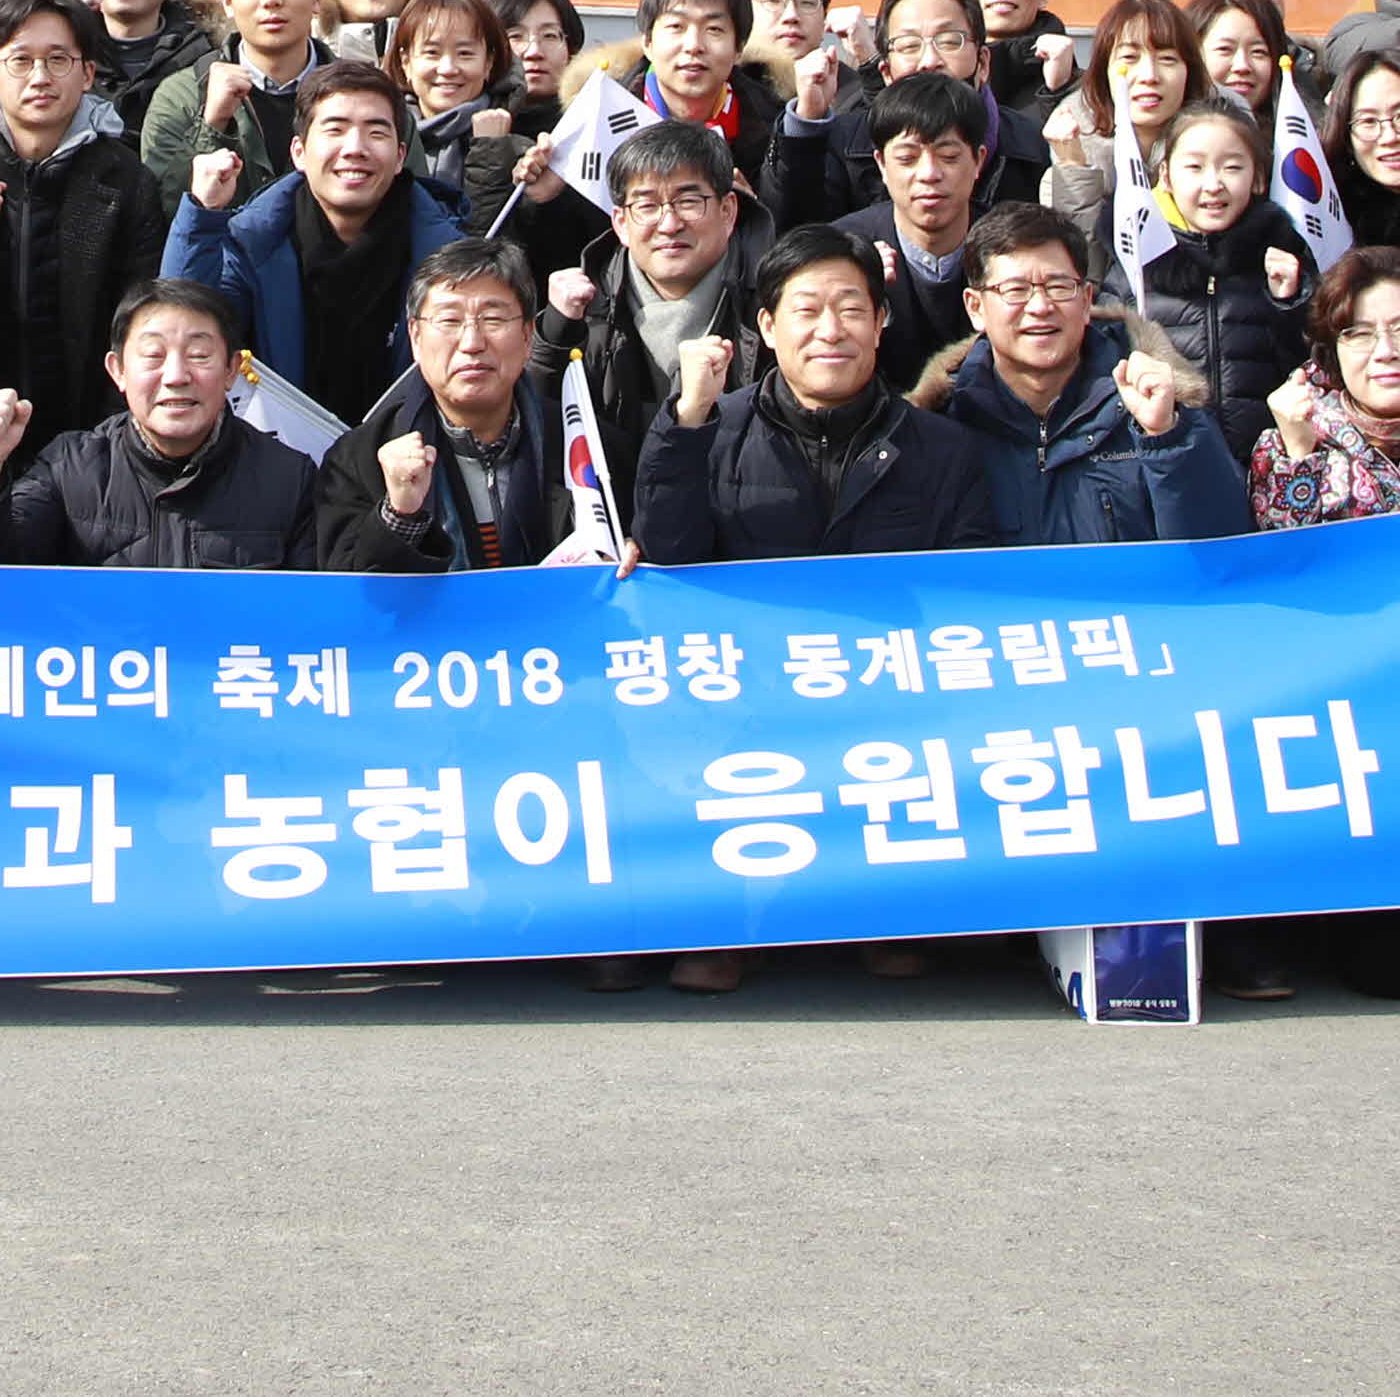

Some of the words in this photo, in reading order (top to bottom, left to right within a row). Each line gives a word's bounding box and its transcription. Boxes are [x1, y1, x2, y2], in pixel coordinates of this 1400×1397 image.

[212, 644, 352, 720] 축제
[393, 648, 566, 710] 2018
[604, 632, 746, 707] 평창
[783, 614, 1177, 700] 동계올림픽」
[209, 760, 614, 902] 농협이
